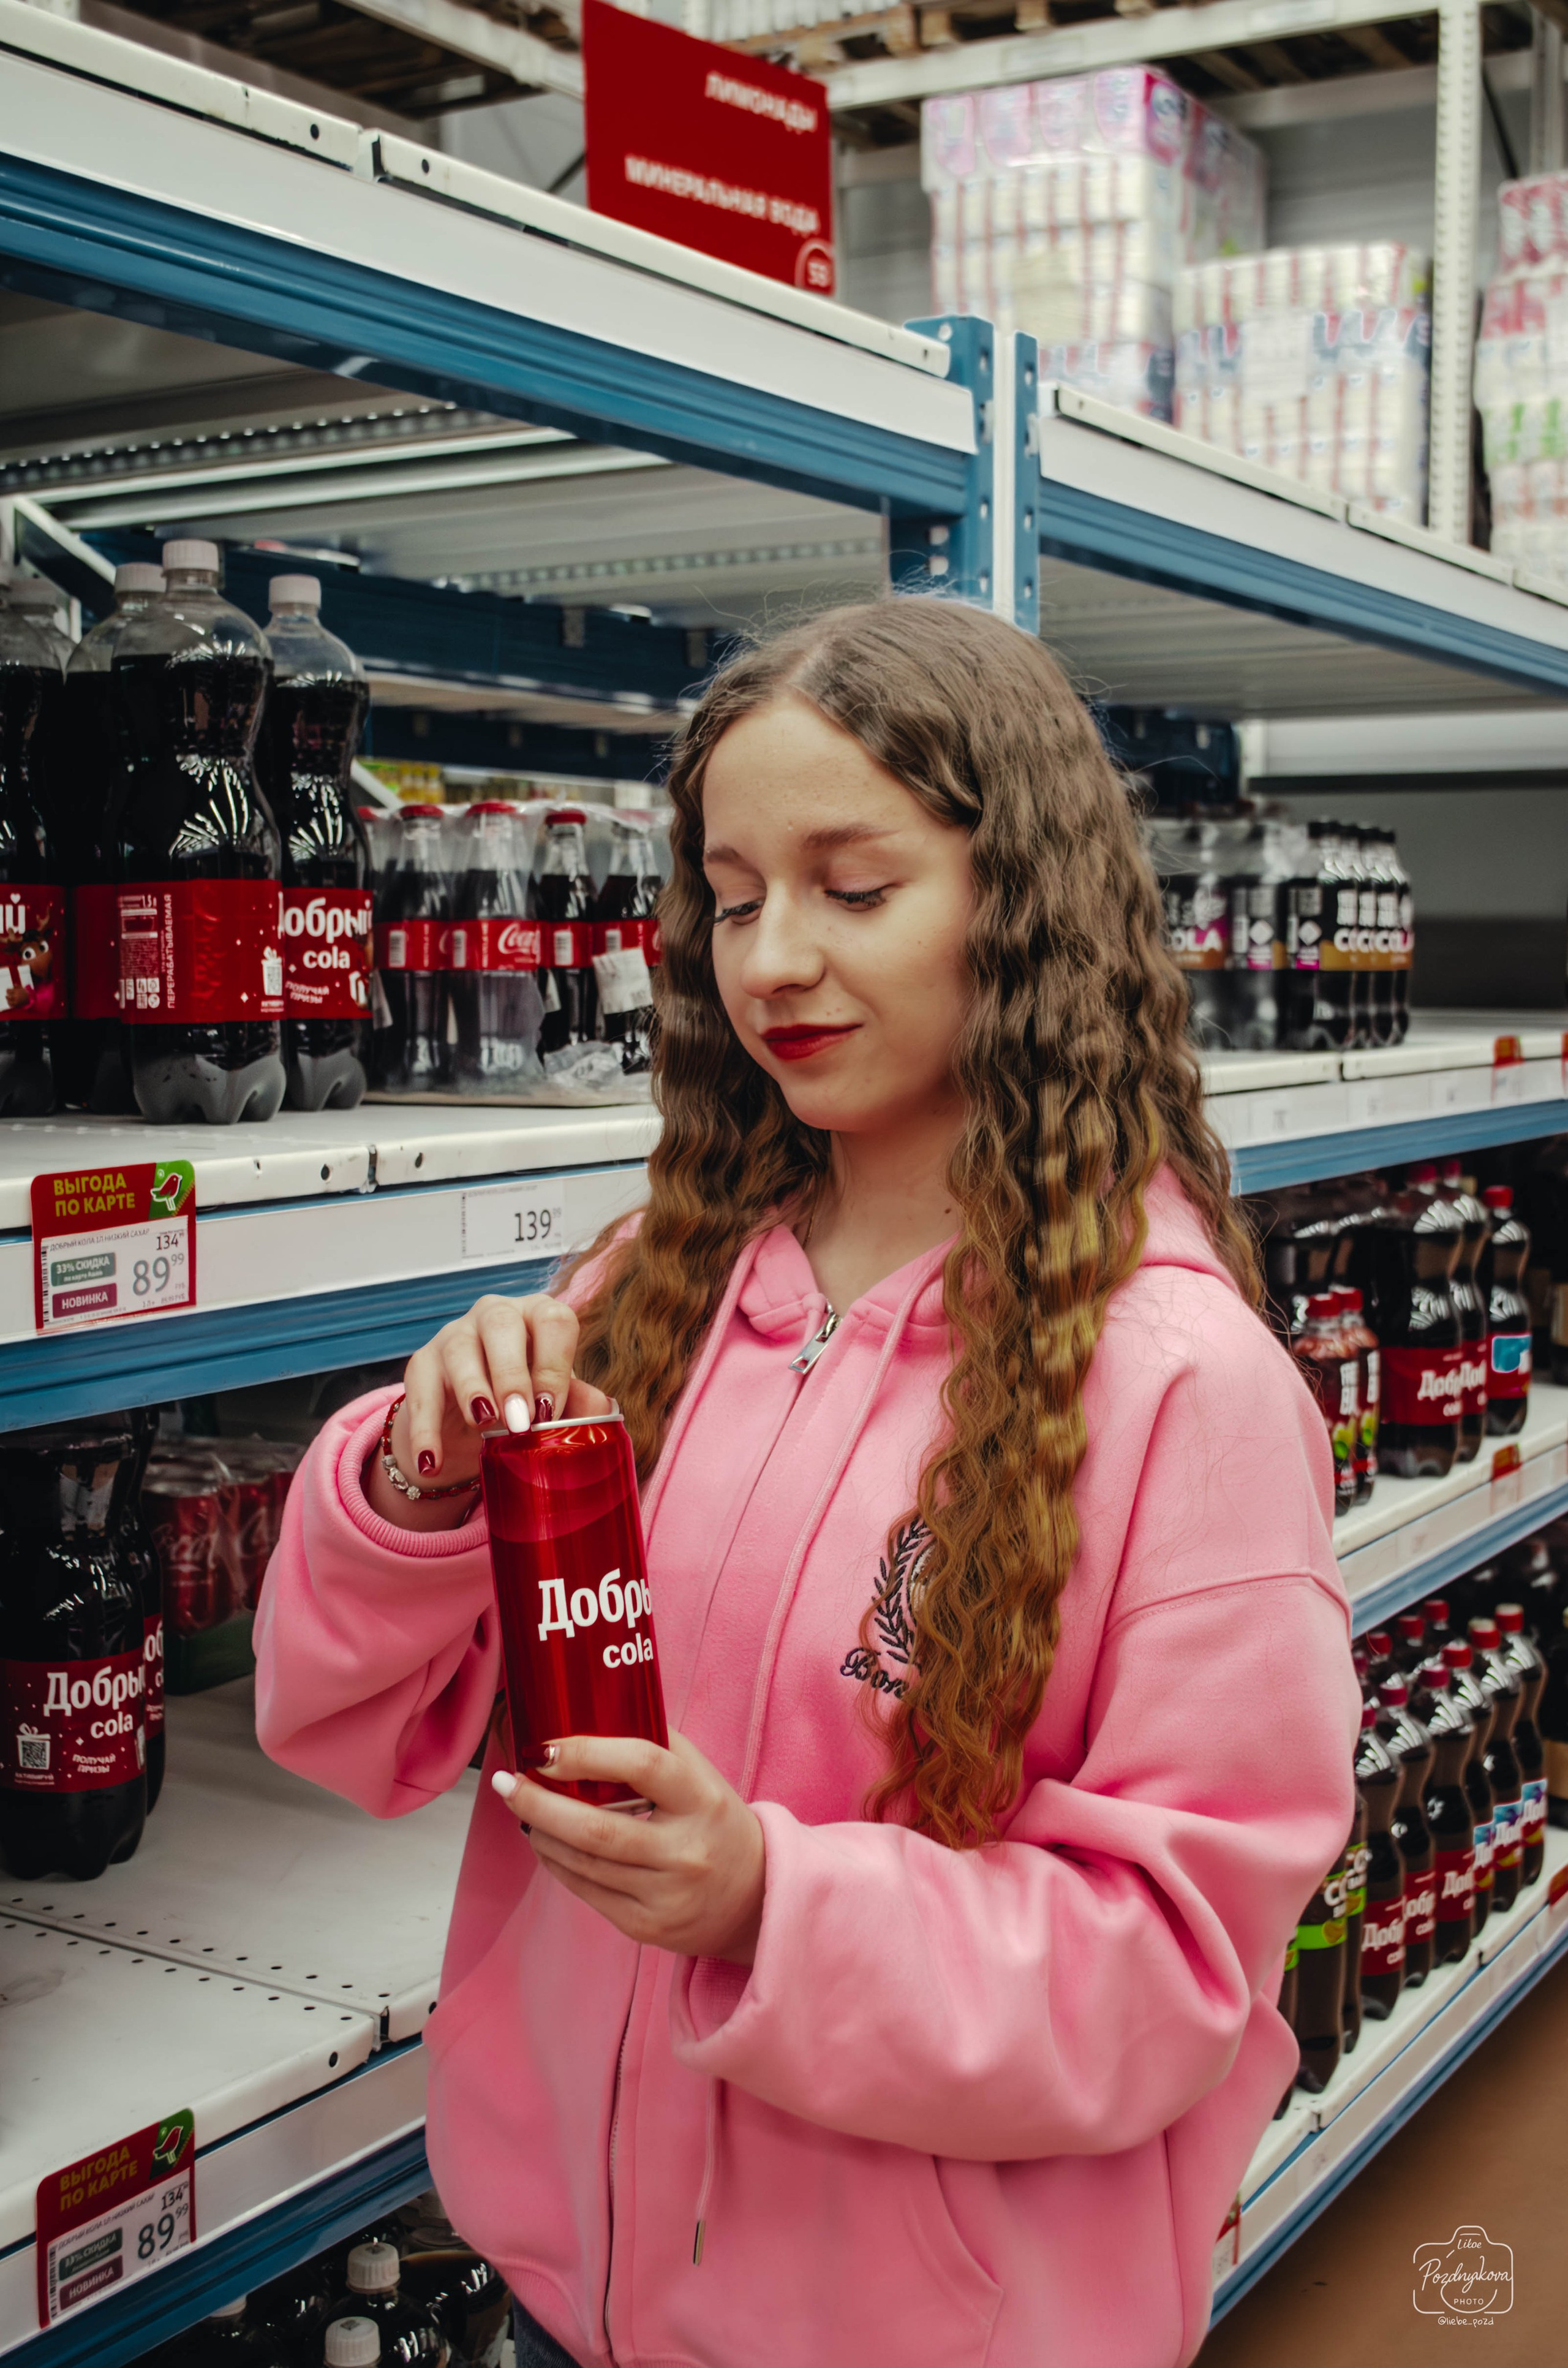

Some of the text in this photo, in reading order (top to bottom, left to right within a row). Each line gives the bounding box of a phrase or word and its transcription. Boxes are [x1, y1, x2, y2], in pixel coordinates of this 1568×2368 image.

[625, 154, 819, 236] МИНЕРАЛЬНАЯ ВОДА
[164, 894, 175, 1008] ПЕРЕРАБАТЫВАЕМАЯ
[303, 945, 350, 969] cola
[53, 1173, 127, 1196] ВЫГОДА
[55, 1192, 135, 1217] ПО КАРТЕ
[78, 1237, 94, 1246] КОЛА
[130, 1228, 150, 1238] САХАР
[514, 1209, 551, 1242] 139
[156, 1233, 179, 1250] 134
[56, 1256, 110, 1274] 33% СКИДКА
[133, 1253, 185, 1296] 89 99
[62, 1292, 108, 1310] НОВИНКА
[603, 1632, 654, 1668] cola
[91, 1711, 134, 1739] cola
[72, 1753, 116, 1763] ПОЛУЧАЙ
[77, 1765, 110, 1773] ПРИЗЫ
[61, 2146, 130, 2192] ВЫГОДА
[61, 2160, 138, 2212] ПО КАРТЕ
[161, 2187, 183, 2211] 134
[138, 2213, 175, 2260] 89
[175, 2203, 189, 2219] 99
[69, 2266, 115, 2300] НОВИНКА
